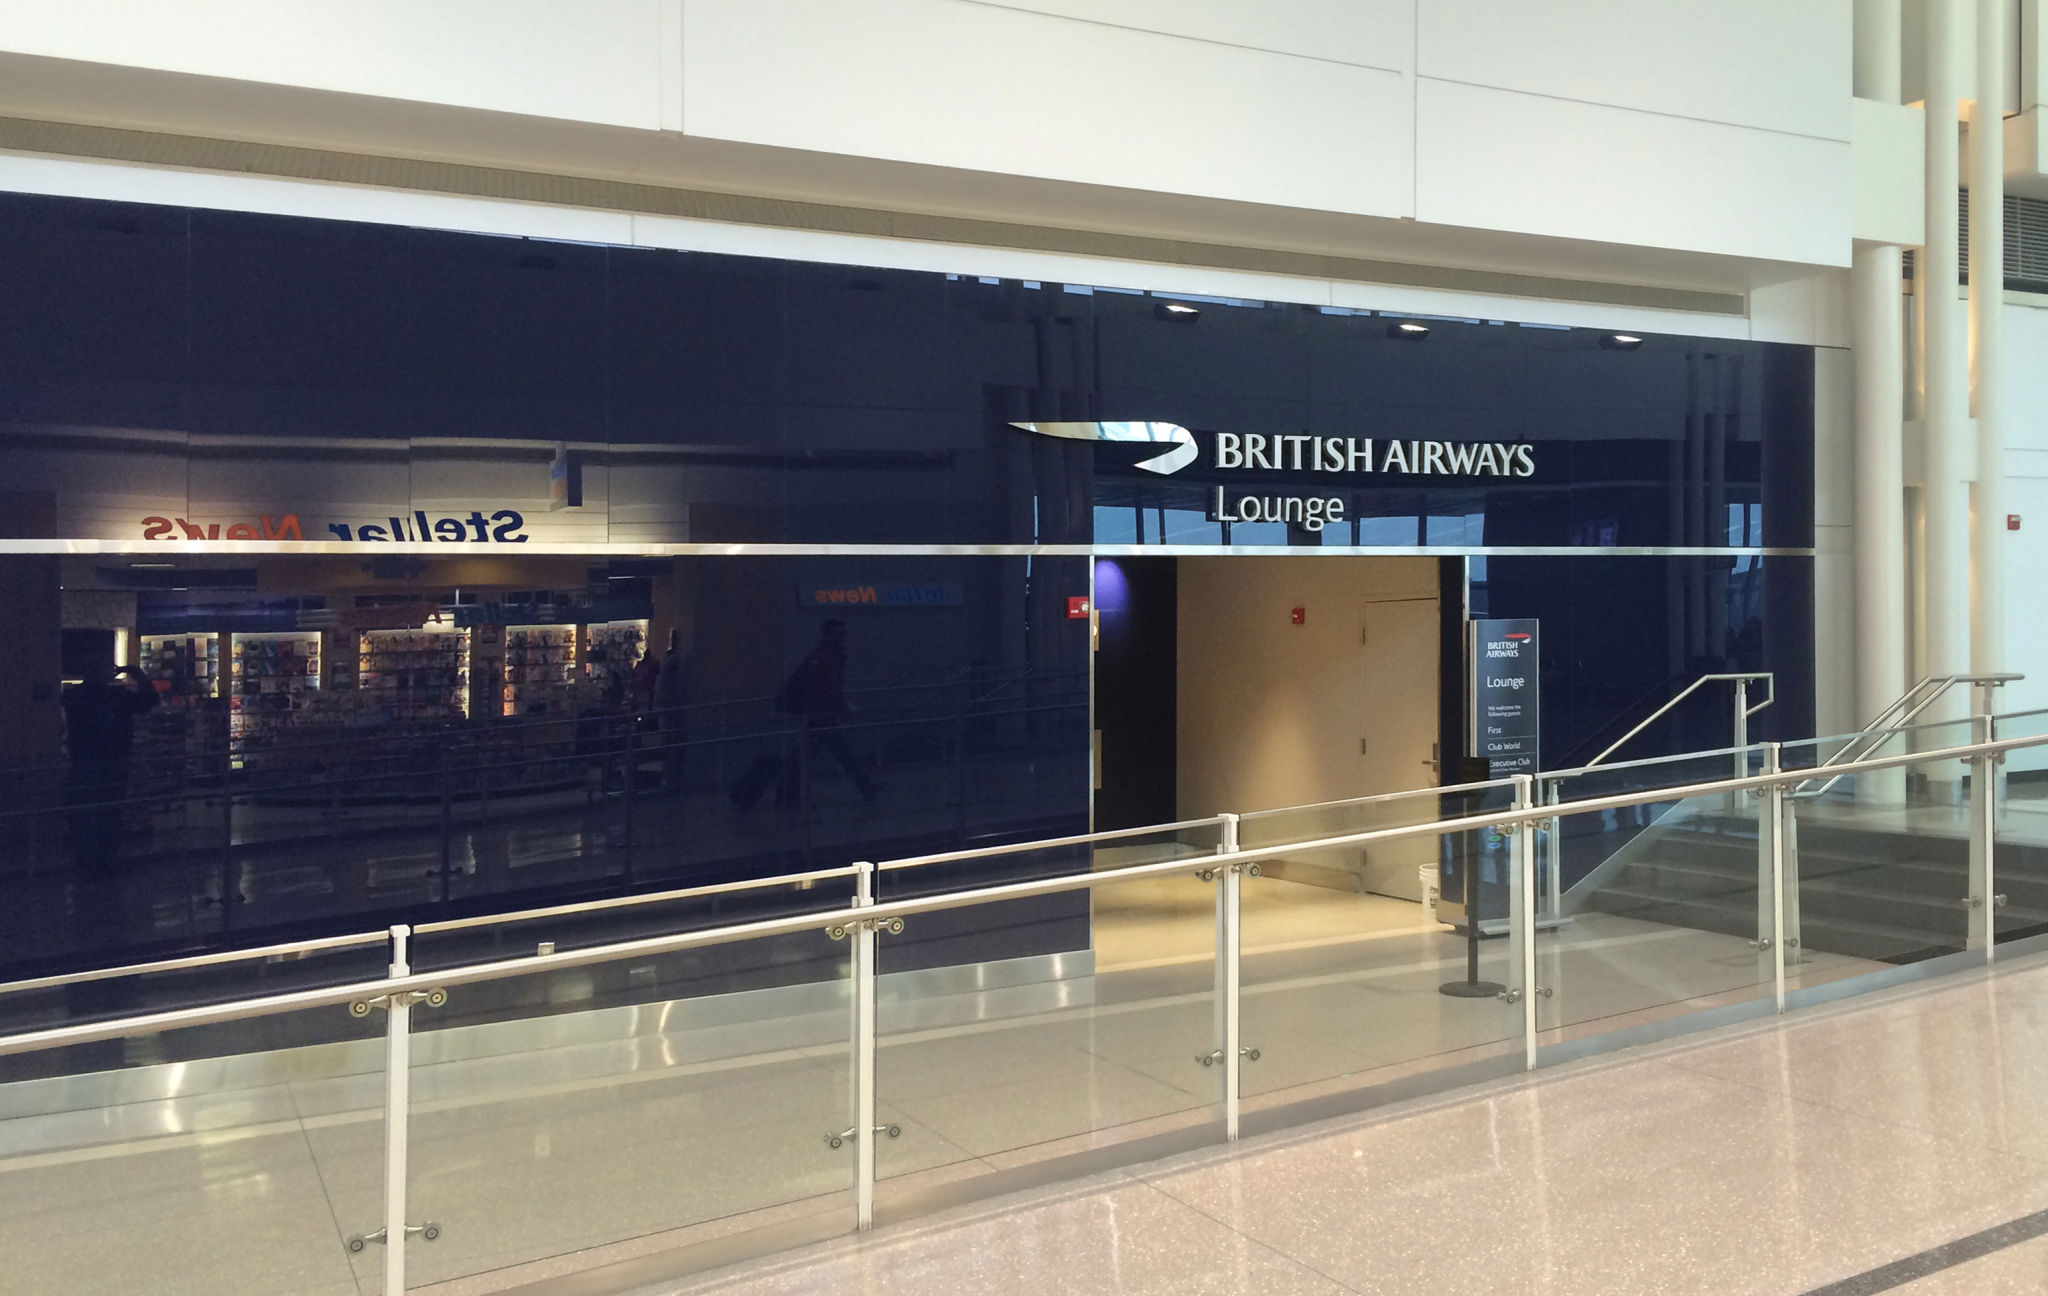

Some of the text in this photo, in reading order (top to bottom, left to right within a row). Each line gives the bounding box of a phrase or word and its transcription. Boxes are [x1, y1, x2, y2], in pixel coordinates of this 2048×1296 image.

[1216, 432, 1535, 477] BRITISH AIRWAYS
[1217, 485, 1345, 531] Lounge
[1488, 641, 1518, 650] BRITISH
[1486, 650, 1519, 658] AIRWAYS
[1487, 676, 1524, 690] Lounge
[1488, 727, 1502, 735] First
[1488, 741, 1521, 751] Club World
[1518, 757, 1530, 766] Club
